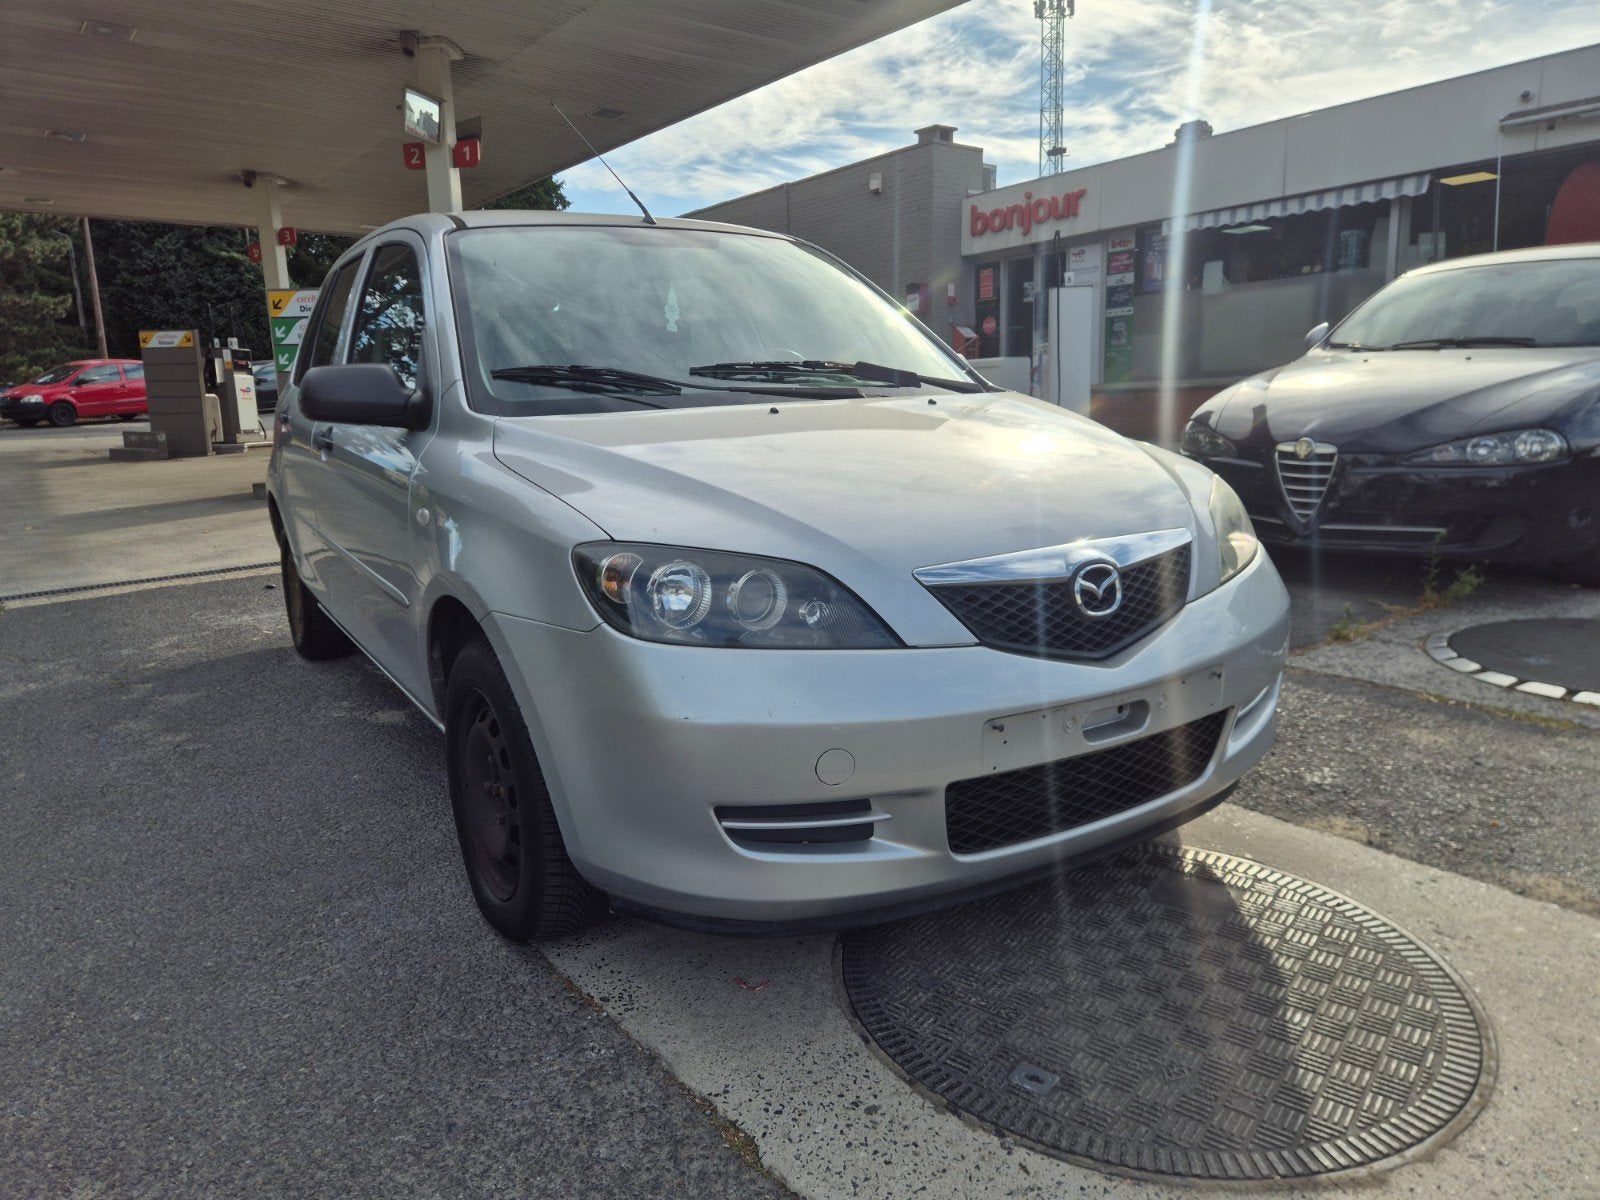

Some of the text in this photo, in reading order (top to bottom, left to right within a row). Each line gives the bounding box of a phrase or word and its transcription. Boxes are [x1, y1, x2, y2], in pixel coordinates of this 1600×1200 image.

[410, 148, 420, 164] 2
[463, 146, 469, 161] 1
[970, 188, 1087, 237] bonjour
[284, 231, 290, 242] 3
